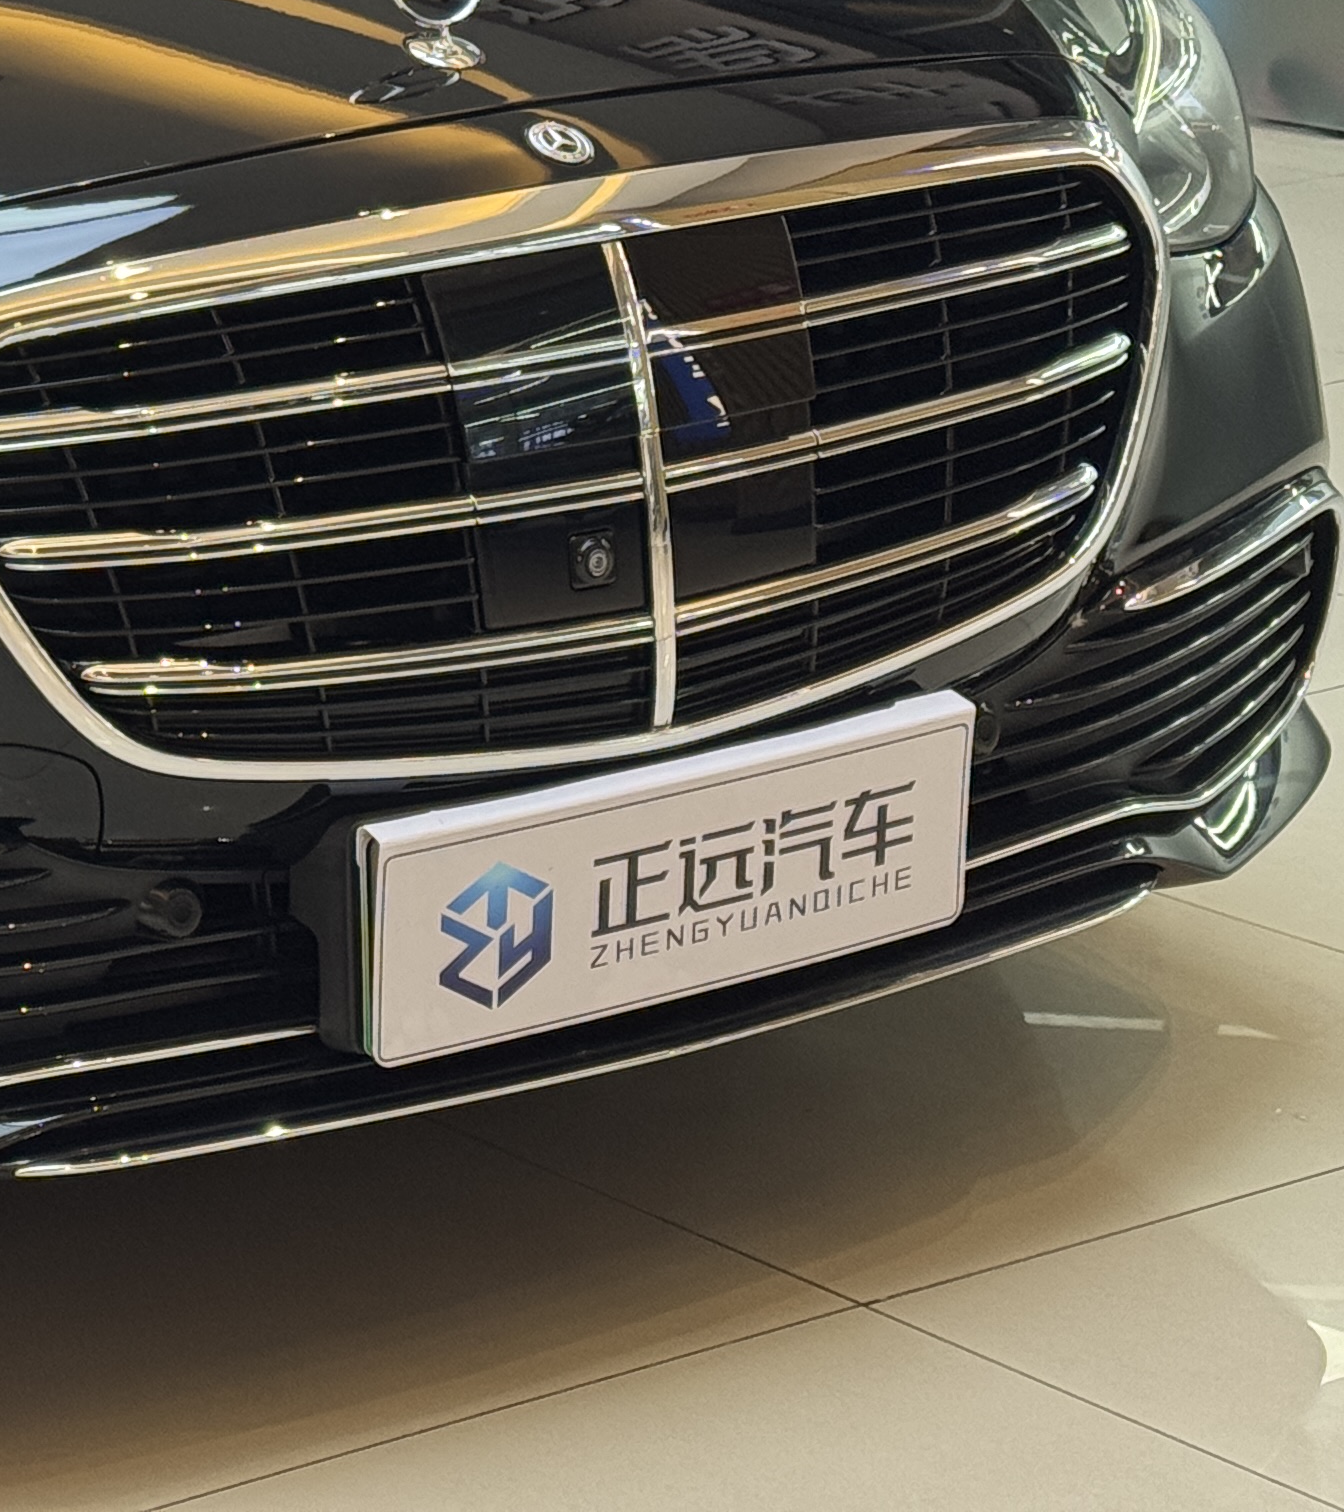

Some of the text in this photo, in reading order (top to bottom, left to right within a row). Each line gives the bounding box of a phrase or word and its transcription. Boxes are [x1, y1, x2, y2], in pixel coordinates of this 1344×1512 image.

[590, 865, 913, 970] ZHENGYUANQICHE
[591, 779, 916, 938] 正远汽车
